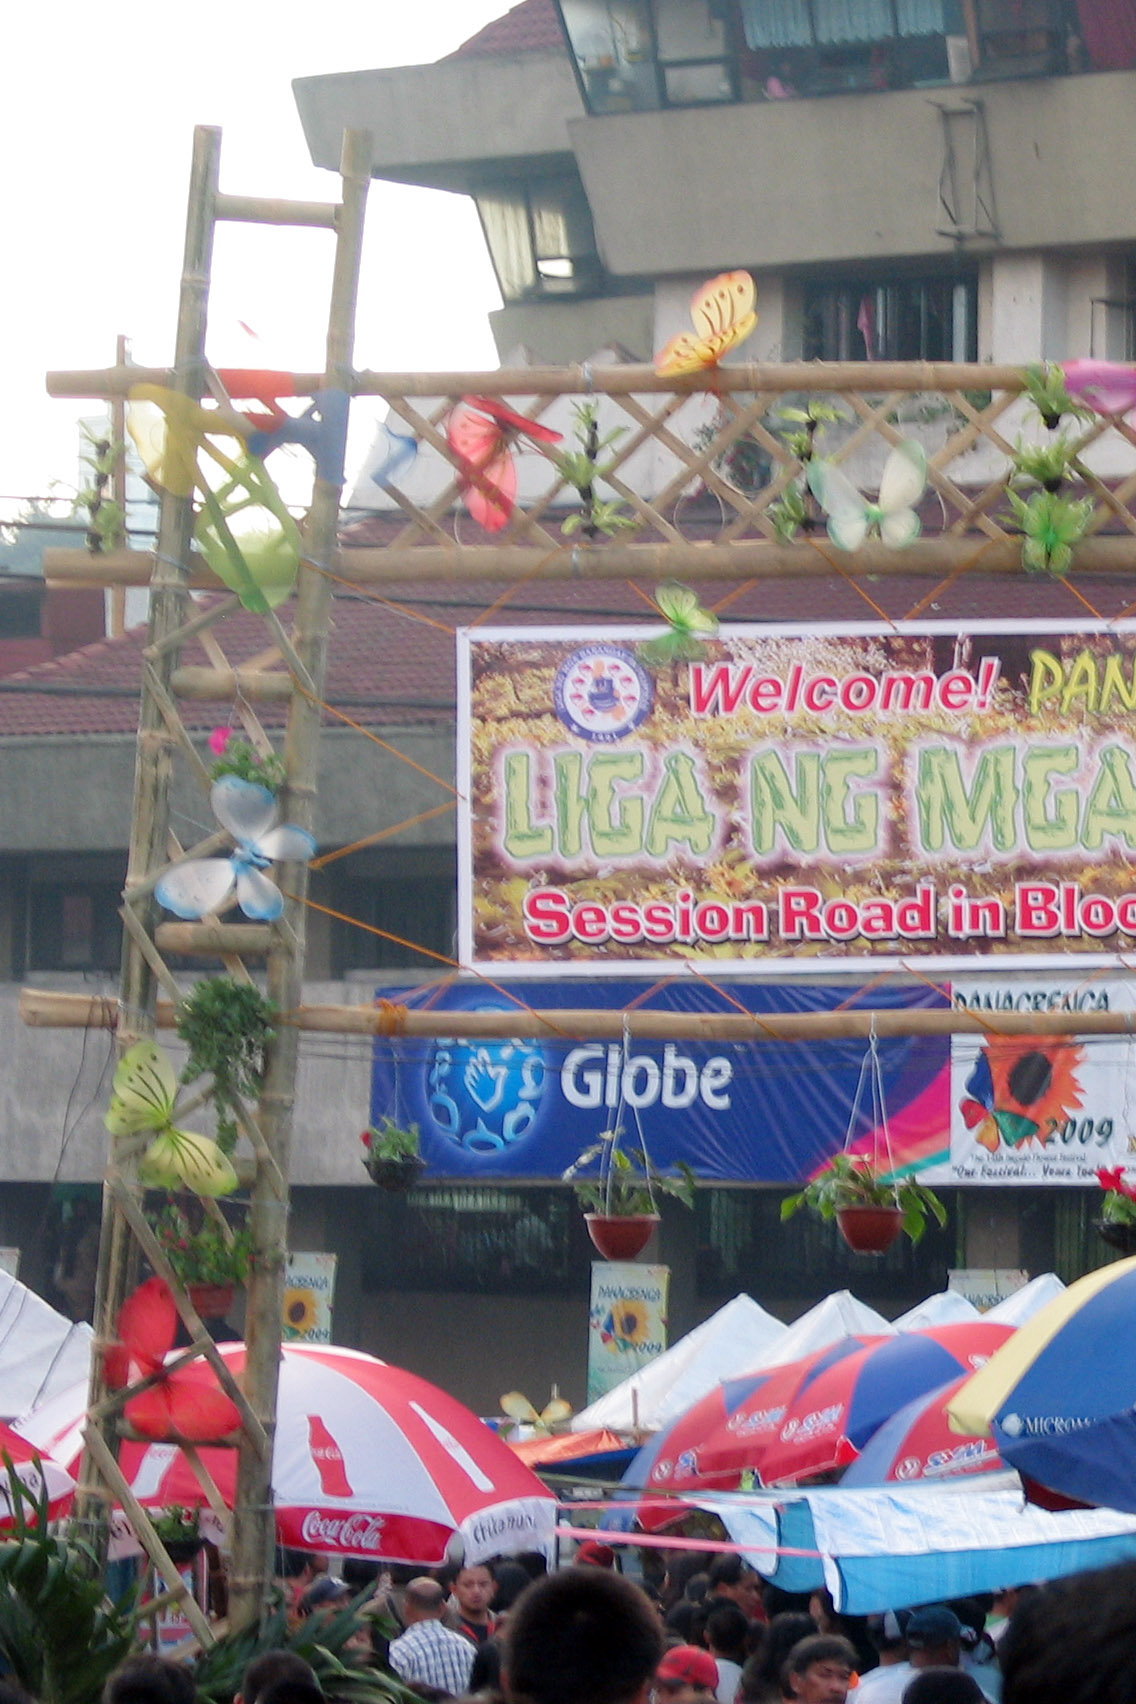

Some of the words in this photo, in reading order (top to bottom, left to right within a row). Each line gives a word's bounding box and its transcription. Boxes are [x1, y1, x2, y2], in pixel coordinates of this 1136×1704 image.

[689, 655, 998, 714] Welcome!
[504, 745, 715, 857] LIGA
[750, 745, 879, 855] NG
[525, 889, 766, 944] Session
[778, 886, 934, 940] Road
[951, 888, 1002, 938] in
[561, 1043, 733, 1111] Globe
[1043, 1116, 1114, 1146] 2009
